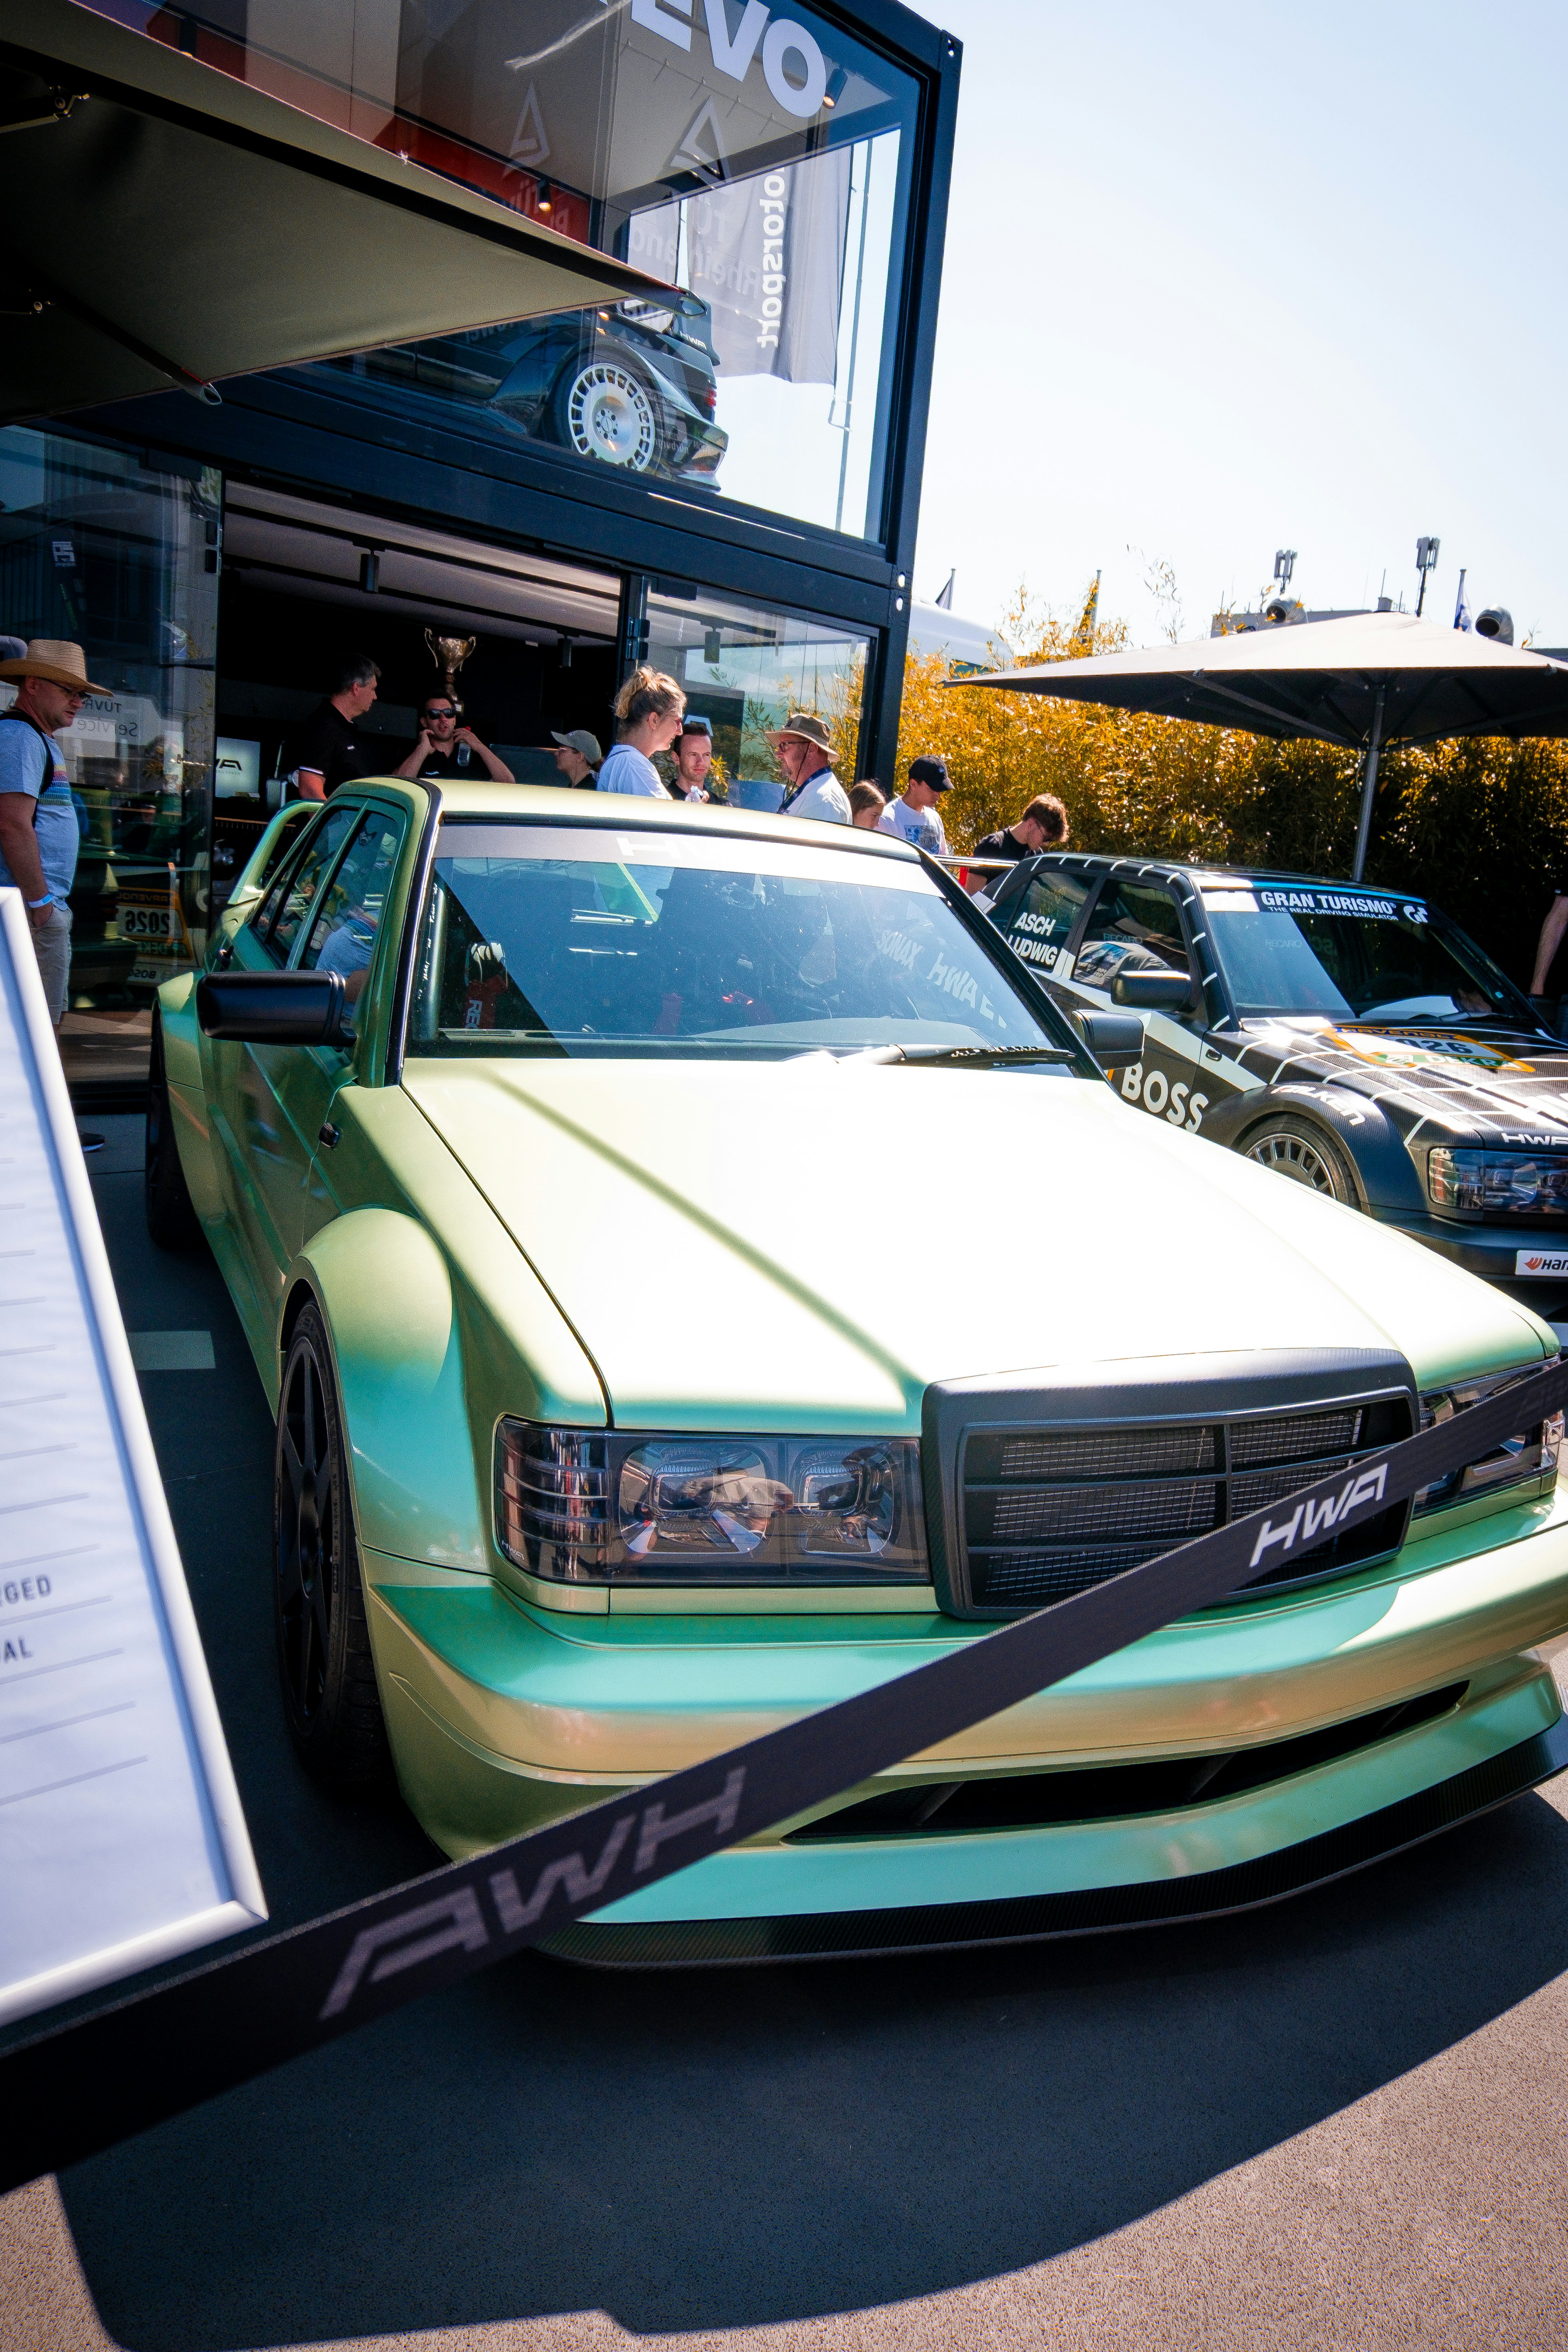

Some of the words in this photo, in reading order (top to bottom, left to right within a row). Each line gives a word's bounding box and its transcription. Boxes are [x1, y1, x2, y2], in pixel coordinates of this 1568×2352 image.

[1261, 892, 1315, 908] GRAN
[1014, 912, 1056, 936] ASCH
[1353, 912, 1399, 921] SIMULATOR
[1103, 932, 1143, 944] RECARO
[926, 952, 979, 1009] HWA
[1394, 1038, 1474, 1054] 026
[1424, 1055, 1524, 1070] DEKRA
[1121, 1063, 1209, 1133] BOSS
[1249, 1463, 1388, 1568] HWA
[502, 1540, 525, 1560] HWA
[0, 1574, 52, 1607] GED
[0, 1636, 34, 1664] AL
